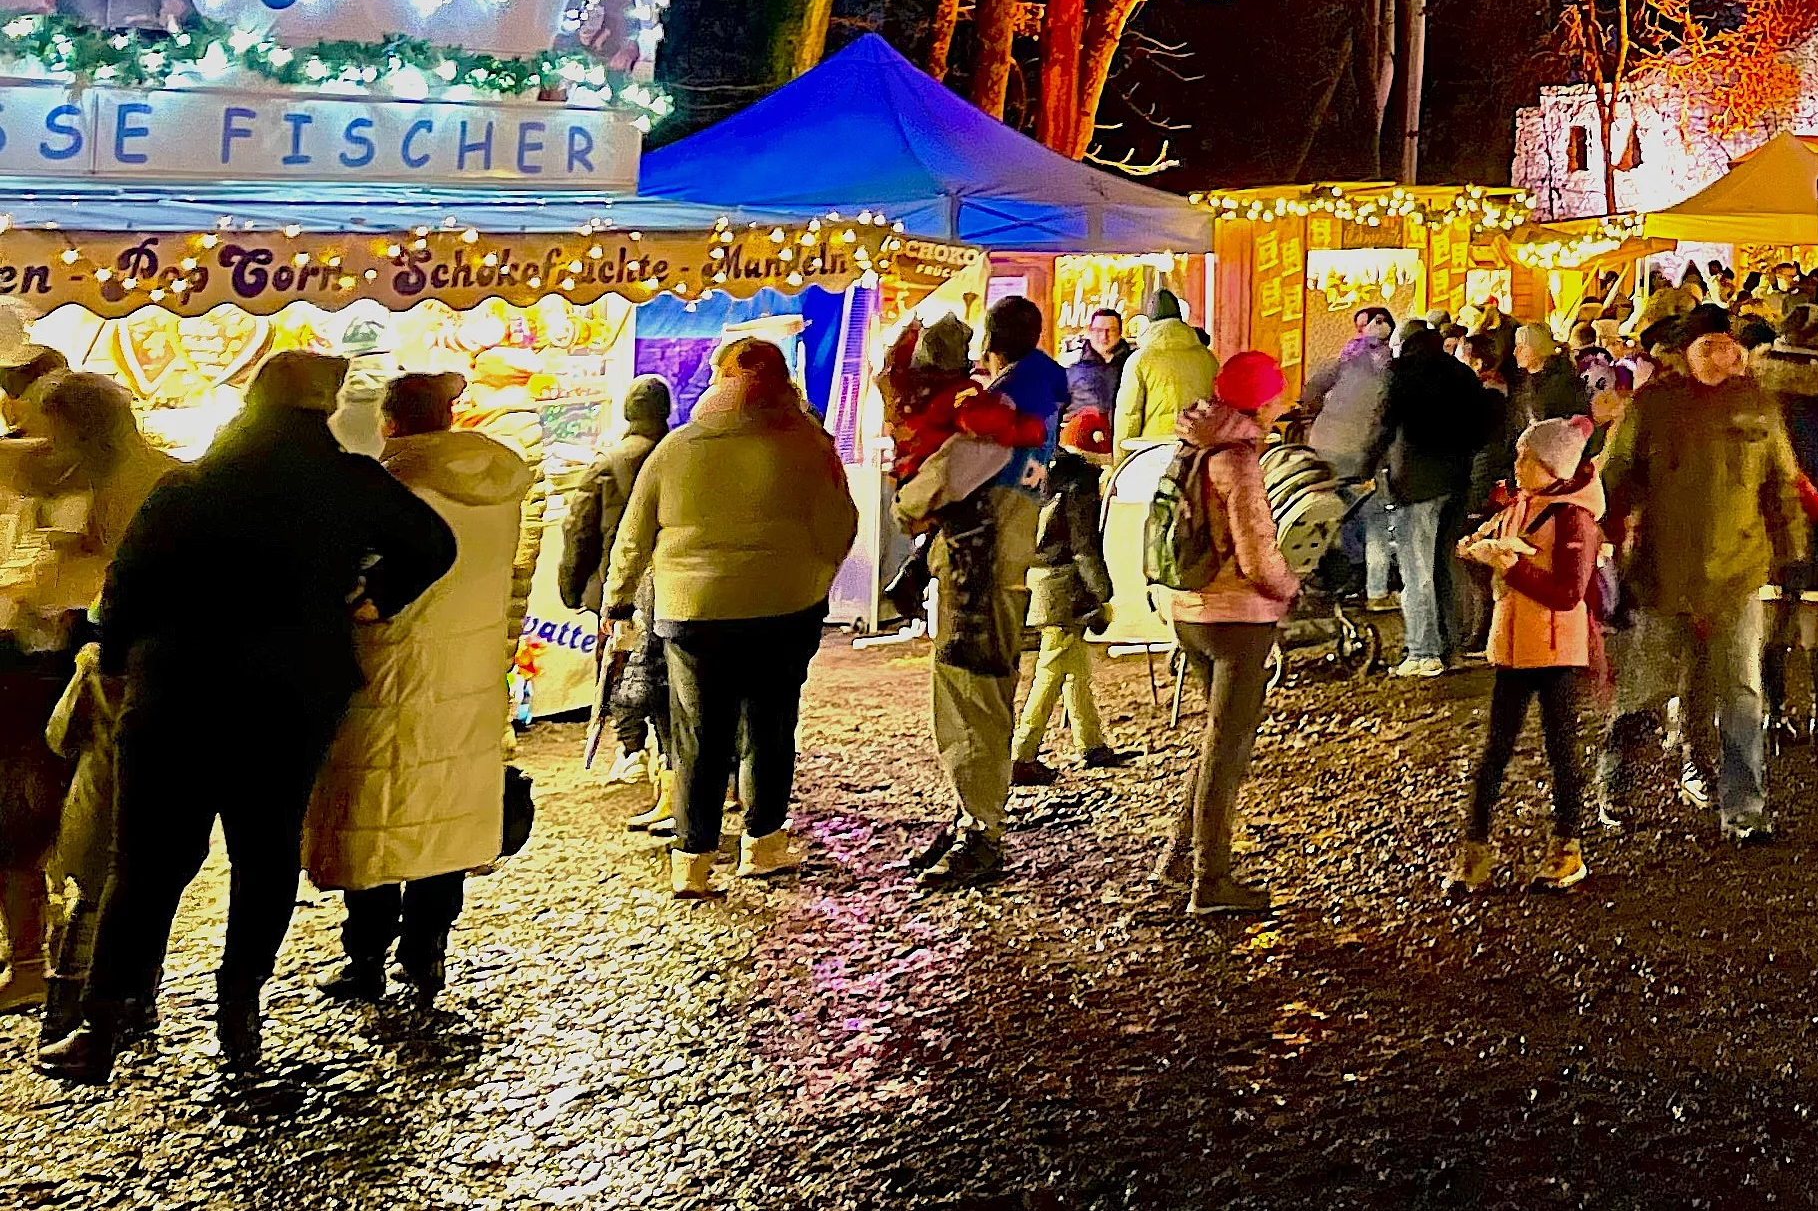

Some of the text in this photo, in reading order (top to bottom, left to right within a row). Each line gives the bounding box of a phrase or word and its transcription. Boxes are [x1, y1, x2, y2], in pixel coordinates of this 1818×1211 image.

[0, 103, 595, 174] SE FISCHER
[101, 237, 209, 306] Pop
[217, 244, 346, 298] Corn
